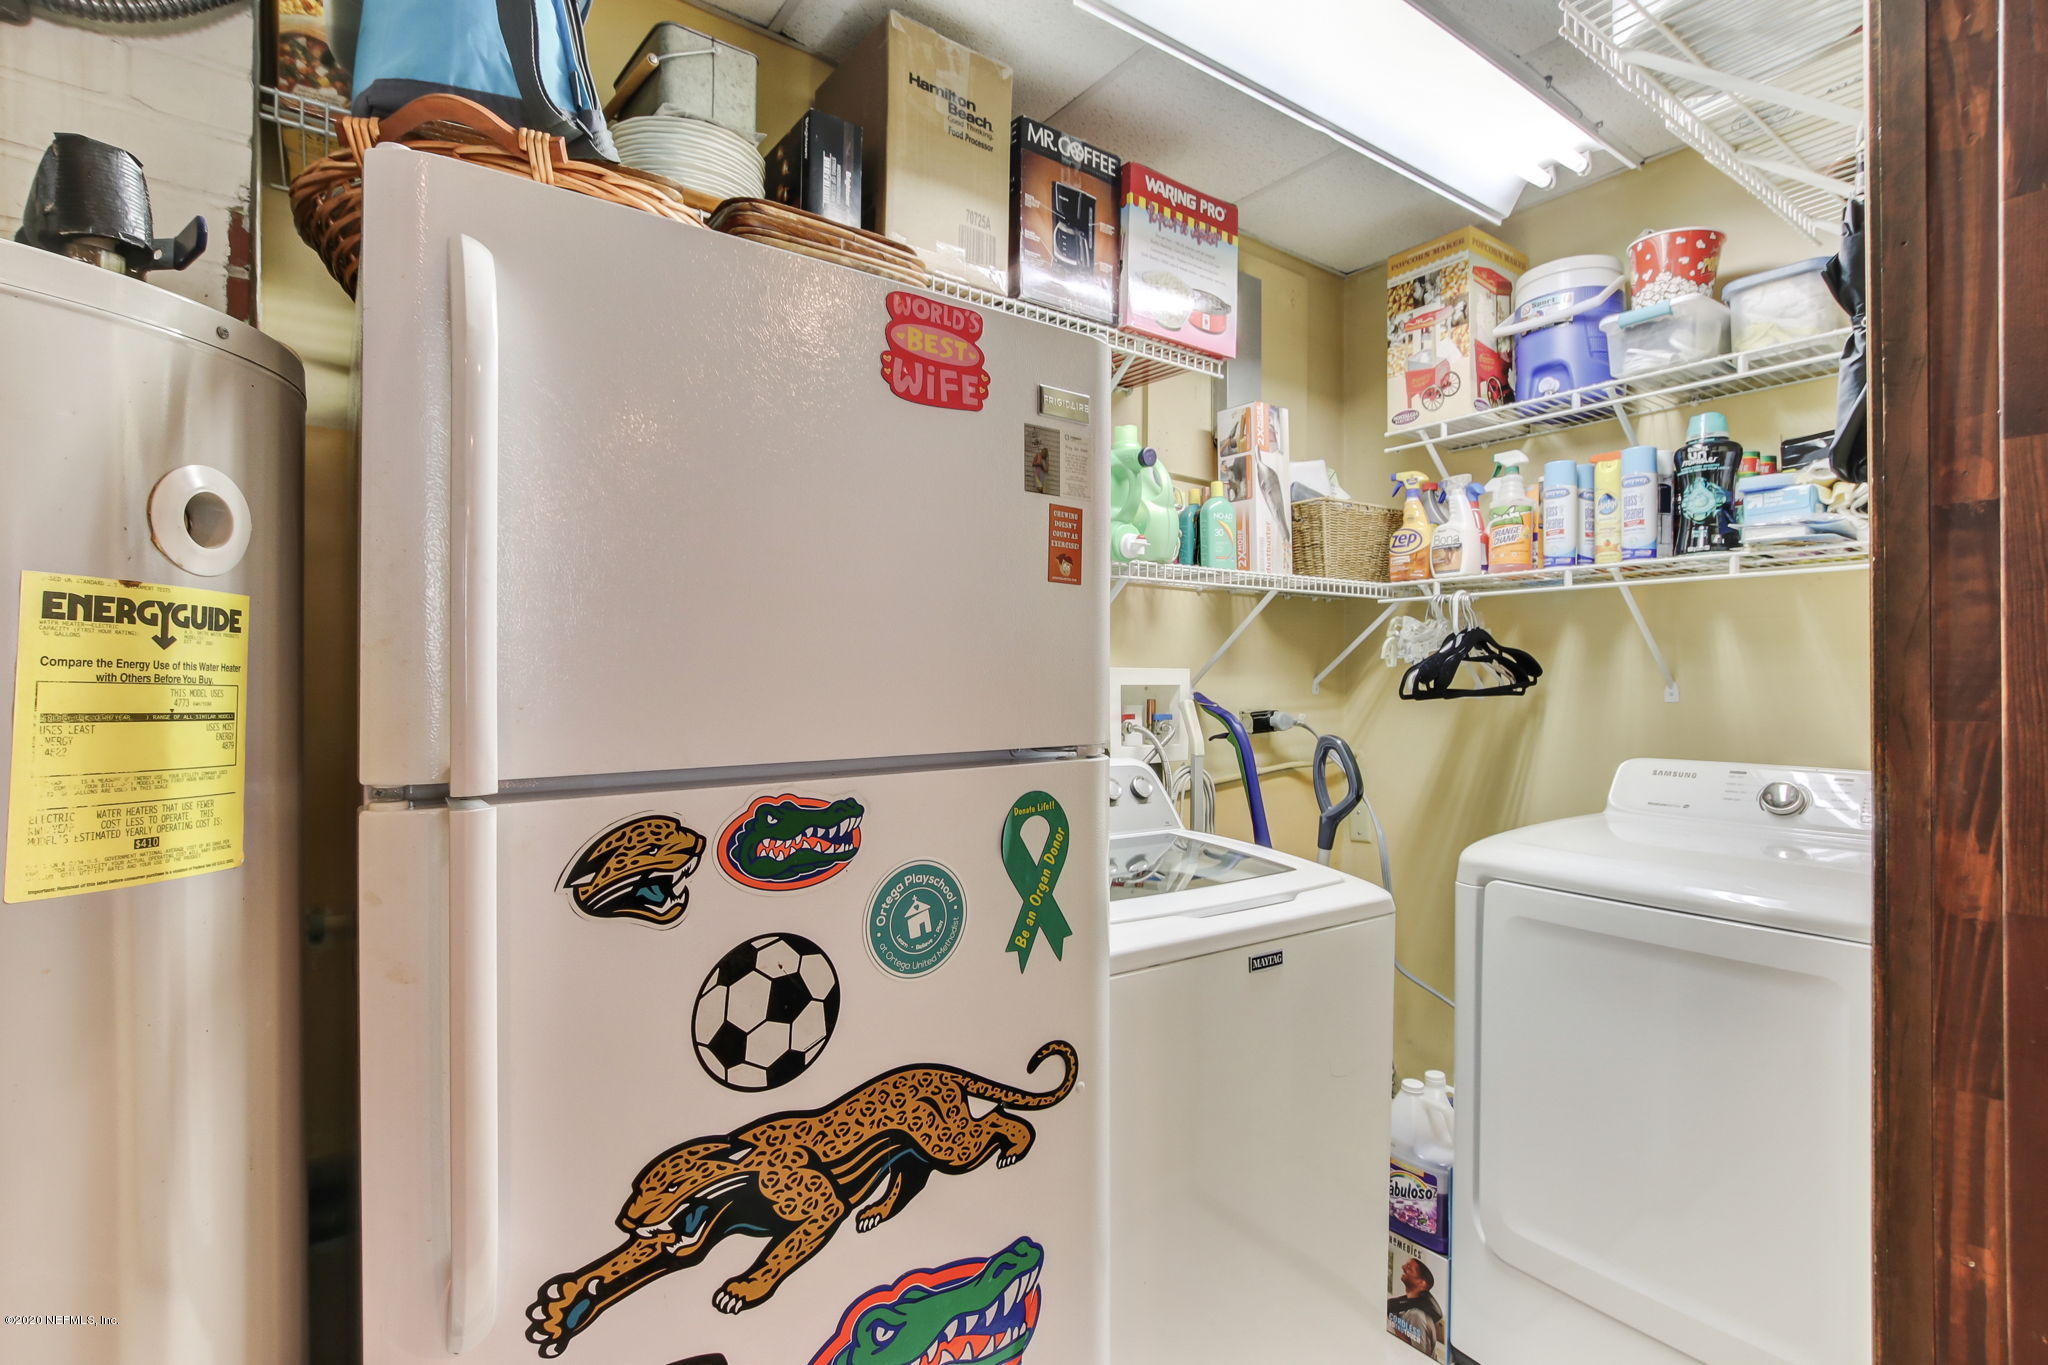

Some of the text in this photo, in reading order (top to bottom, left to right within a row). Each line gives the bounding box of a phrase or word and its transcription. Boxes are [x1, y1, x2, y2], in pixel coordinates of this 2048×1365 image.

[909, 72, 976, 112] Hamilton
[948, 103, 992, 132] Beach
[948, 115, 964, 128] Good
[948, 126, 994, 152] Food Processor
[1058, 135, 1116, 177] COFFEE
[1145, 174, 1226, 222] WARING PRO
[966, 208, 992, 231] 70725A
[1392, 238, 1464, 272] POPCORN MAKER
[1472, 237, 1502, 259] POPCORN
[893, 294, 980, 334] WORLD'S
[907, 326, 968, 360] BEST
[1043, 394, 1089, 413] FRIGIDAIRE
[1052, 530, 1070, 539] COUNT
[1054, 520, 1077, 530] DOESN'T
[1215, 528, 1223, 536] 30
[1434, 535, 1460, 546] Bona
[1238, 551, 1247, 567] 2X
[42, 590, 242, 635] ENERGYGUIDE
[40, 656, 241, 672] Compare the Energy Use of this Water Heater
[96, 673, 213, 684] with Others Before You Buy.
[170, 689, 187, 697] THIS
[189, 689, 208, 698] MODEL
[173, 698, 190, 708] 4773
[206, 722, 235, 731] USES MOST
[216, 732, 234, 741] ENERGY
[1652, 770, 1697, 779] SAMSUNG
[97, 809, 121, 819] WATER
[126, 805, 158, 816] HEATERS
[162, 803, 178, 813] THAT
[182, 802, 193, 810] USE
[197, 800, 214, 809] FEWER
[1014, 801, 1055, 816] Donate Life!!
[101, 819, 120, 829] COST
[126, 816, 144, 827] LESS
[149, 816, 157, 824] TO
[200, 809, 214, 818] THIS
[74, 830, 121, 842] ESTIMATED
[126, 826, 153, 837] YEARLY
[157, 821, 192, 833] OPERATING
[196, 819, 210, 828] COST
[213, 818, 223, 826] IS:
[135, 838, 159, 849] $410
[1015, 827, 1065, 948] Be an Organ Donor
[876, 873, 956, 926] Ortega Playschool
[880, 916, 959, 972] at Ortega United Methodist
[896, 920, 944, 950] Learn Believe Play
[1253, 954, 1282, 968] MAYTAG
[1390, 1180, 1433, 1200] abuloso
